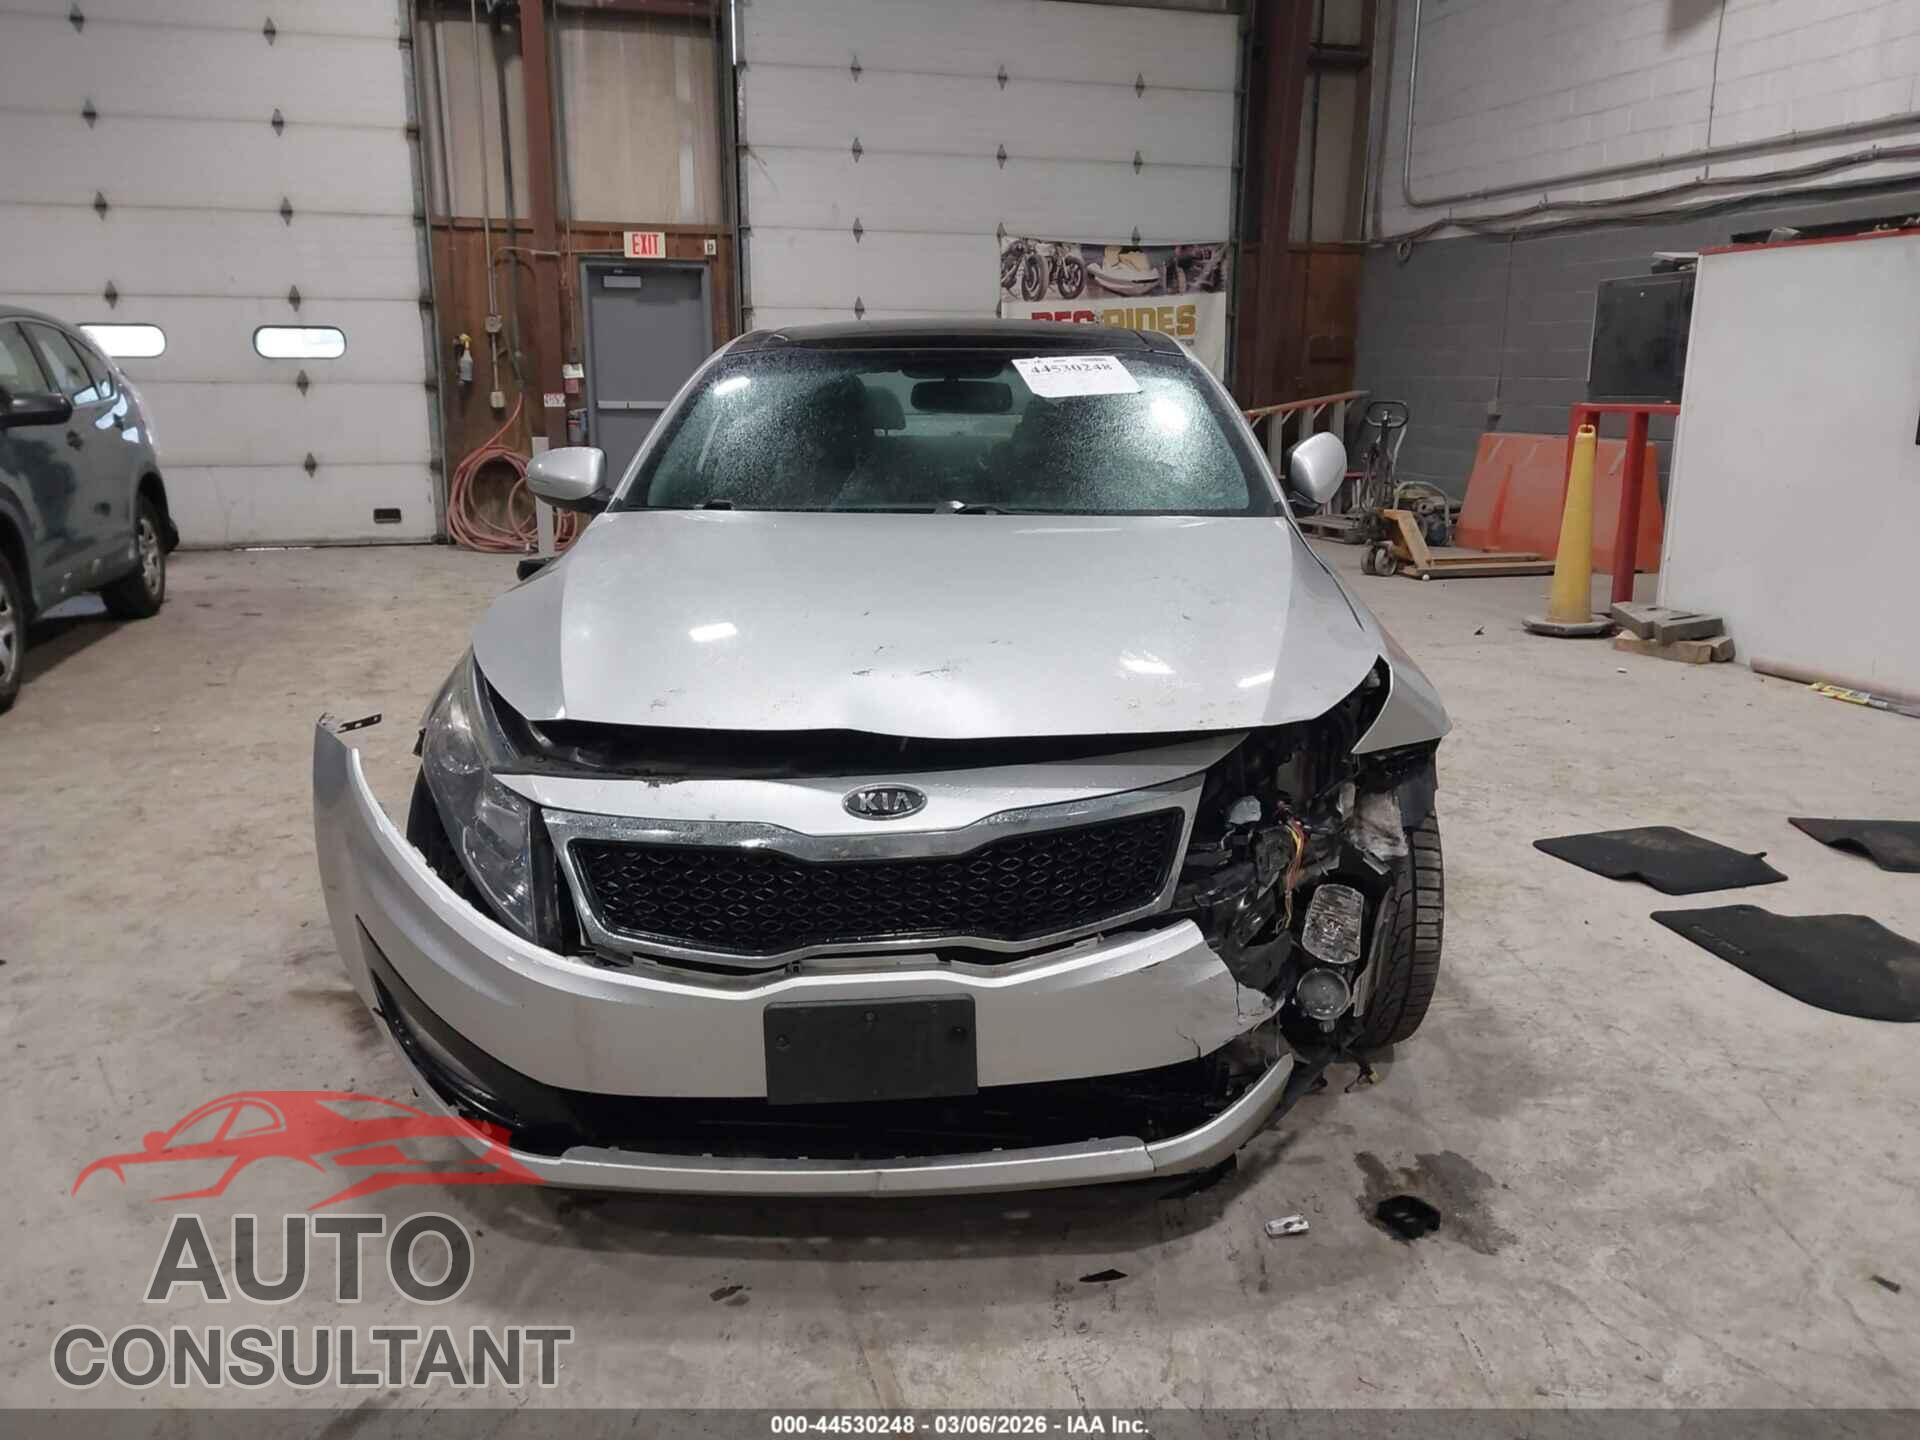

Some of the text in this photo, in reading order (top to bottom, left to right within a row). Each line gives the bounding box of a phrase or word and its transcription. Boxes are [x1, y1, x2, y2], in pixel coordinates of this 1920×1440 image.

[632, 233, 660, 256] EXIT
[1031, 363, 1113, 373] 44530248
[858, 792, 913, 811] KIA
